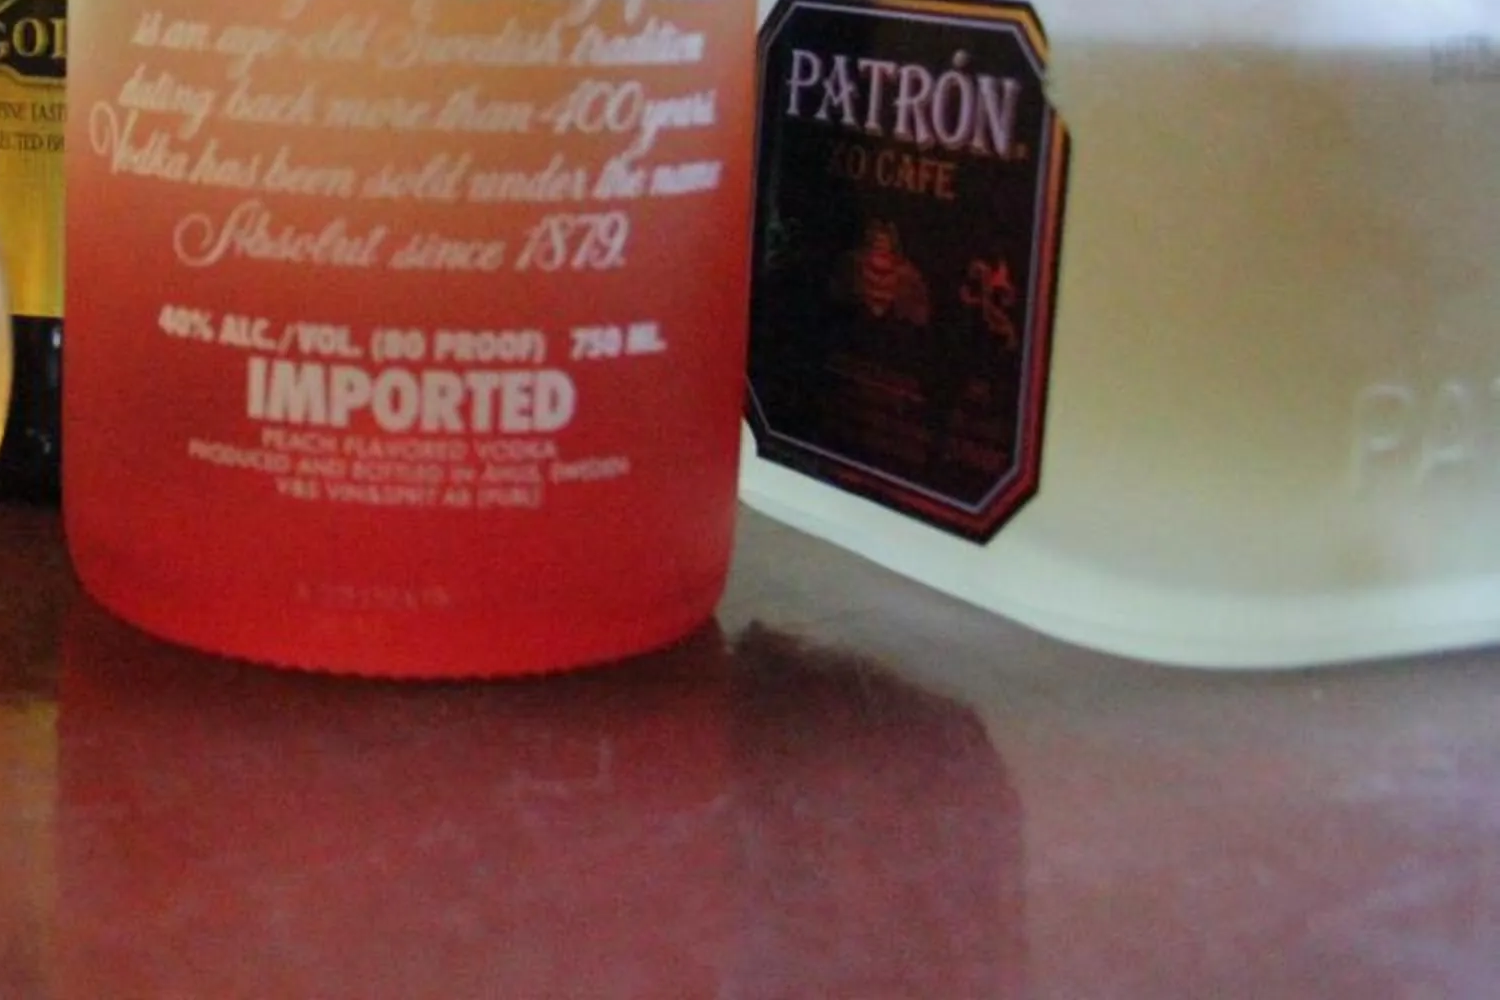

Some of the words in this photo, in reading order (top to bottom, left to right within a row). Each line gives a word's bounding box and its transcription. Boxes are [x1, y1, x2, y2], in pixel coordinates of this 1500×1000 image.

[785, 49, 1022, 158] PATRÓN
[173, 199, 389, 269] Absolut
[390, 233, 507, 272] since
[247, 354, 577, 435] IMPORTED
